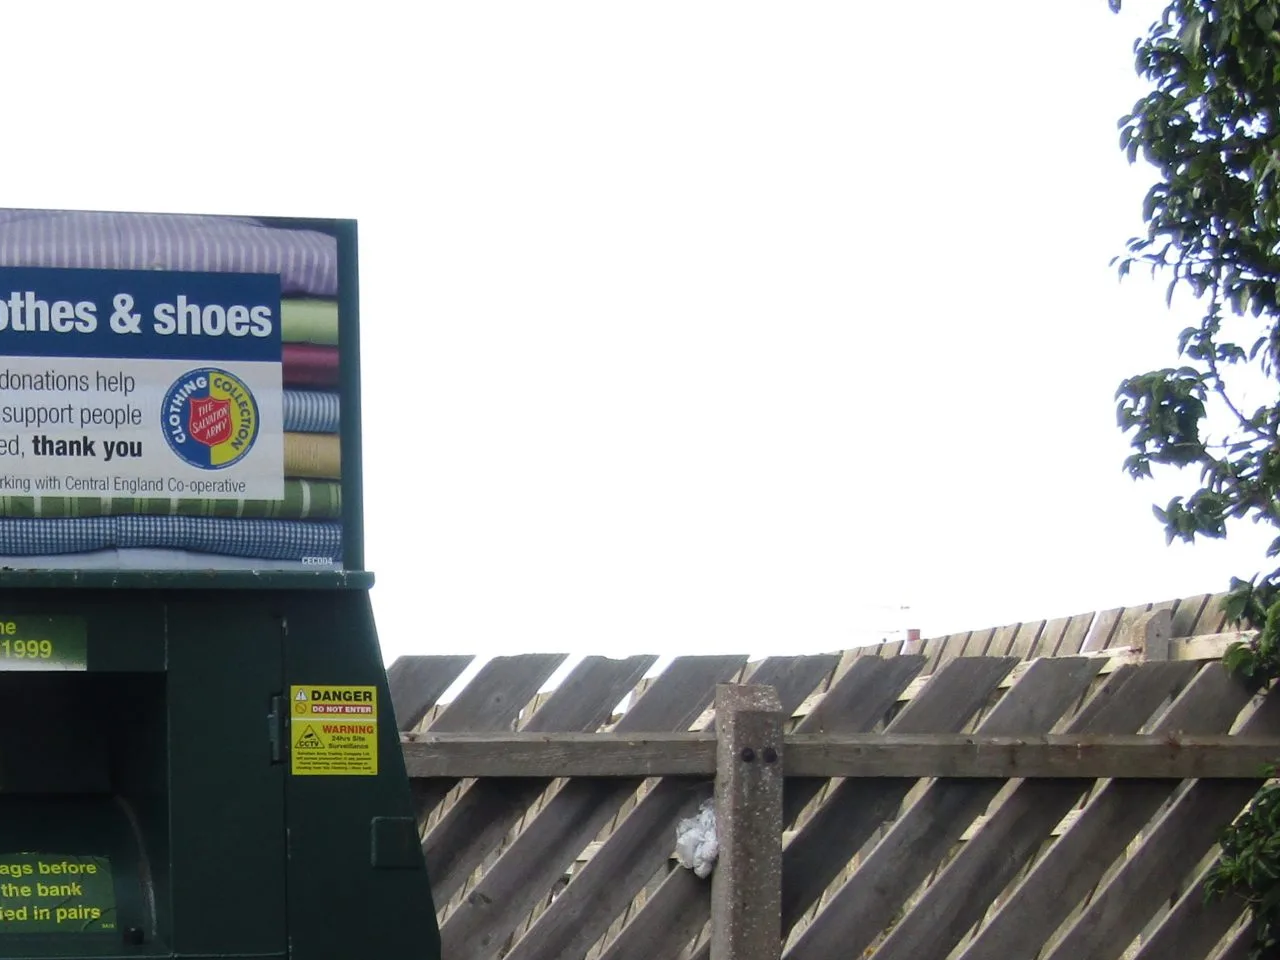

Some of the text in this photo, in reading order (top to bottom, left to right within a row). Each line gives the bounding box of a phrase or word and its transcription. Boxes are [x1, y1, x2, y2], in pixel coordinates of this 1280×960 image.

[110, 293, 142, 334] &
[153, 295, 272, 337] shoes
[96, 371, 135, 396] help
[2, 402, 73, 427] support
[80, 405, 142, 429] people
[169, 376, 251, 450] CLOTHING COLLECTION
[192, 405, 228, 433] SALVATION
[199, 402, 214, 417] THE
[206, 418, 227, 440] ARMY
[32, 434, 96, 457] thank
[103, 441, 143, 462] you
[35, 475, 61, 490] with
[65, 476, 110, 491] Central
[114, 477, 164, 494] England
[167, 477, 246, 494] Co-operative
[312, 690, 372, 701] DANGER
[322, 725, 374, 734] WARNING
[38, 861, 97, 875] before
[1, 883, 32, 897] the
[37, 882, 82, 897] bank
[33, 905, 51, 920] in
[56, 904, 101, 924] pairs
